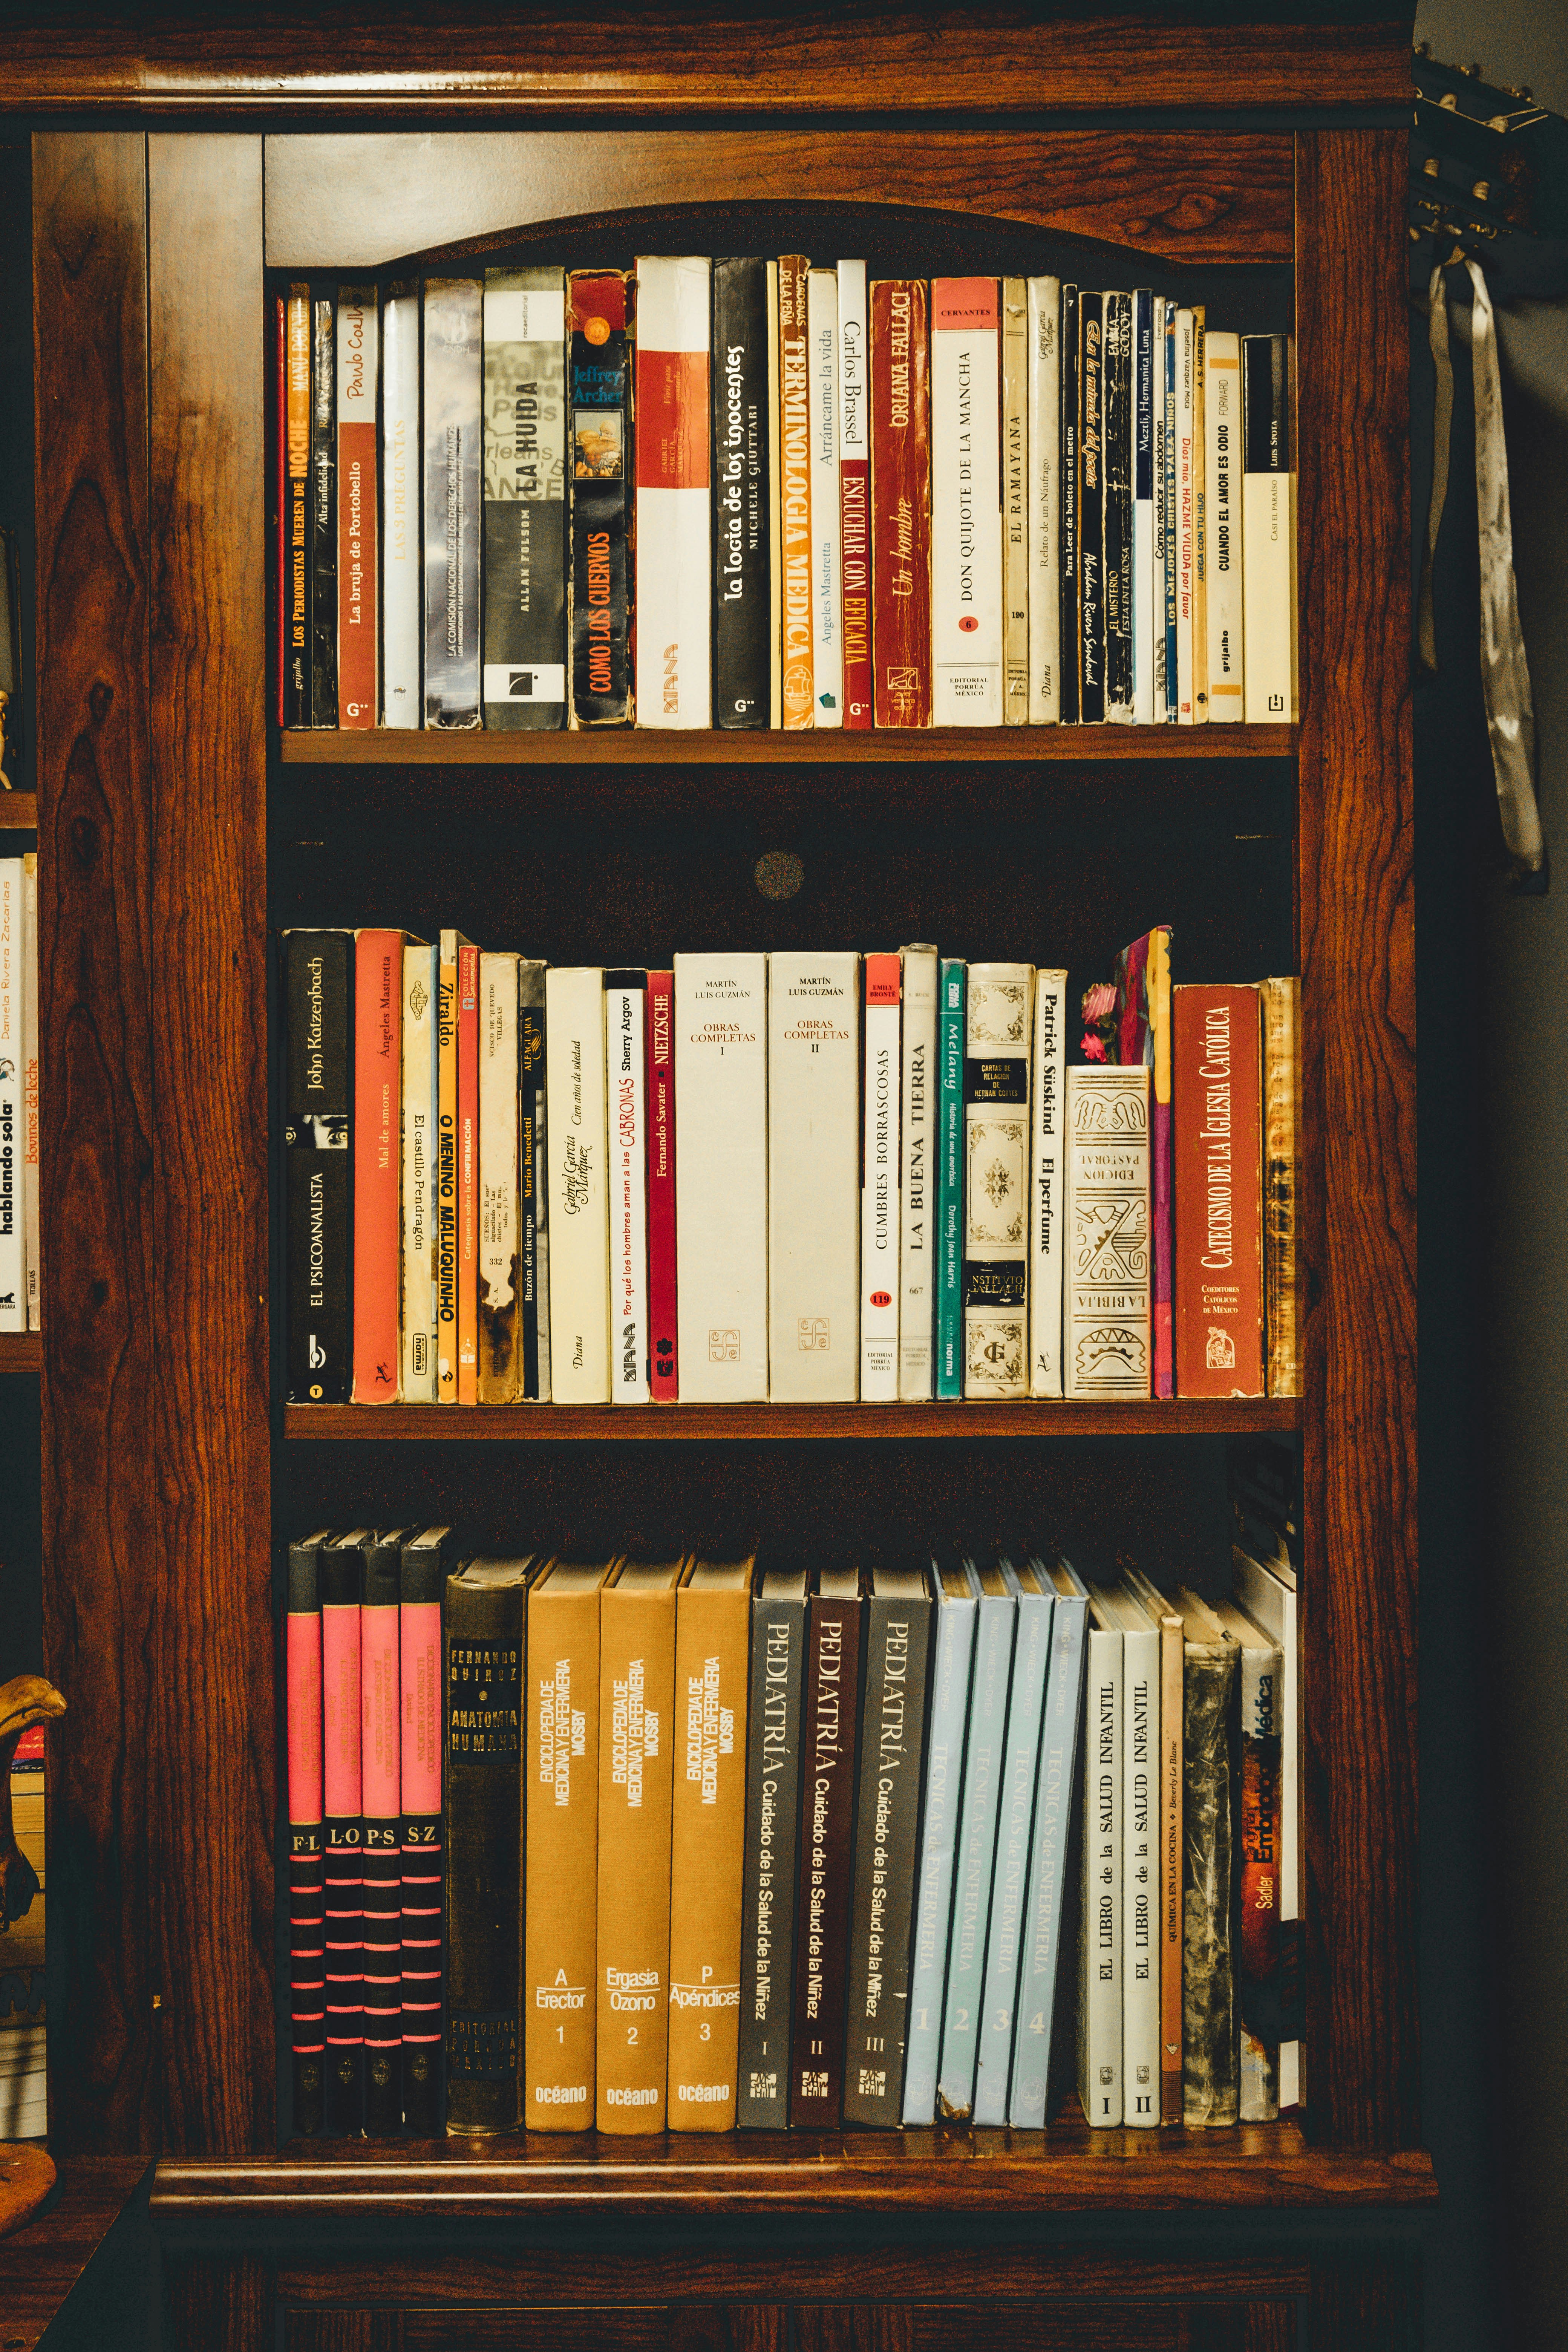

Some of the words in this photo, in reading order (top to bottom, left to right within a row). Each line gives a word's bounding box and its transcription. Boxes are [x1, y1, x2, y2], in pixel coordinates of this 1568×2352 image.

[891, 292, 909, 356] FALLACI
[820, 330, 831, 360] vida
[844, 322, 861, 377] Carlos
[820, 365, 831, 377] la
[723, 346, 744, 446] inocentes
[891, 363, 909, 426] ORIANA
[959, 352, 971, 425] MANCHA
[516, 382, 537, 452] HUIDA
[820, 383, 832, 466] Arráncame
[844, 385, 862, 444] Brassel
[289, 420, 308, 477] NOCHE
[749, 406, 761, 475] GIUTTARI
[960, 433, 971, 452] LA
[1218, 426, 1228, 451] ODIO
[723, 453, 744, 481] los
[960, 459, 971, 480] DE
[1010, 416, 1021, 514] RAMAYANA
[1066, 458, 1073, 467] el
[1067, 470, 1073, 481] en
[1219, 456, 1228, 469] ES
[294, 482, 304, 496] DE
[516, 464, 537, 492] LA
[1219, 473, 1228, 504] AMOR
[350, 462, 360, 536] Portobello
[723, 487, 742, 511] de
[292, 501, 305, 546] MUEREN
[749, 483, 758, 550] MICHELE
[844, 477, 865, 555] ESCUCHAR
[890, 498, 912, 560] hombre
[961, 487, 974, 557] QUIJOTE
[1066, 517, 1073, 528] de
[1219, 509, 1229, 521] EL
[521, 510, 529, 561] FOLSOM
[1011, 523, 1021, 543] EL
[1219, 525, 1229, 571] CUANDO
[350, 541, 360, 558] de
[350, 562, 363, 601] bruja
[588, 532, 611, 605] CUERVOS
[821, 543, 831, 596] Mastretta
[845, 561, 865, 591] CON
[892, 570, 913, 596] Un
[962, 565, 972, 601] DON
[292, 551, 305, 621] PERIODISTAS
[521, 568, 530, 612] ALLAN
[724, 579, 742, 600] la
[350, 606, 360, 624] La
[589, 609, 611, 641] LOS
[822, 600, 834, 645] Angeles
[292, 626, 304, 647] LOS
[845, 598, 867, 665] EFICACIA
[292, 658, 303, 689] grijalbo
[589, 646, 612, 692] COMO
[308, 957, 324, 1049] Katzenbach
[621, 996, 631, 1031] Argov
[654, 995, 669, 1064] NIETZSCHE
[784, 1031, 849, 1039] COMPLETAS
[798, 1020, 833, 1029] OBRAS
[1045, 994, 1057, 1058] Patrick
[571, 1041, 581, 1071] soledad
[622, 1035, 632, 1071] Sherry
[812, 1044, 819, 1053] II
[1199, 1007, 1231, 1078] CATÓLICA
[308, 1054, 323, 1089] John
[572, 1072, 581, 1083] de
[911, 1044, 924, 1125] TIERRA
[572, 1084, 581, 1104] años
[656, 1083, 666, 1122] Savater
[877, 1050, 888, 1164] BORRASCOSAS
[1043, 1065, 1056, 1135] Süskind
[0, 1103, 12, 1141] sola
[415, 1115, 424, 1128] El
[571, 1105, 582, 1125] Cien
[619, 1078, 635, 1147] CABRONAS
[1200, 1083, 1231, 1138] IGLESIA
[415, 1132, 423, 1177] castillo
[524, 1118, 533, 1165] Benedetti
[657, 1126, 666, 1177] Fernando
[1208, 1142, 1231, 1161] LA
[622, 1152, 630, 1167] las
[910, 1138, 924, 1210] BUENA
[1042, 1158, 1054, 1173] El
[1208, 1164, 1231, 1182] DE
[0, 1146, 12, 1235] hablando
[524, 1169, 532, 1197] Mario
[415, 1181, 424, 1250] Pendragón
[876, 1173, 888, 1250] CUMBRES
[1038, 1178, 1054, 1254] perfume
[311, 1173, 323, 1285] PSICOANALISTA
[525, 1215, 534, 1250] tiempo
[622, 1211, 631, 1256] hombres
[910, 1222, 923, 1250] LA
[1201, 1187, 1232, 1268] CATECISMO
[525, 1254, 533, 1266] de
[311, 1291, 323, 1306] EL
[622, 1279, 634, 1296] qué
[623, 1300, 632, 1315] Por
[815, 1620, 843, 1772] PEDIATRÍA
[1100, 1682, 1113, 1764] INFANTIL
[1170, 1767, 1176, 1777] Le
[1100, 1775, 1112, 1833] SALUD
[1169, 1779, 1178, 1808] Beverly
[813, 1778, 830, 1843] Cuidado
[331, 1828, 360, 1844] L-O
[368, 1829, 395, 1845] P-S
[408, 1826, 435, 1842] S-Z
[813, 1847, 826, 1867] de
[1100, 1845, 1112, 1857] la
[812, 1871, 825, 1885] la
[1100, 1868, 1112, 1884] de
[1169, 1866, 1176, 1879] LA
[1169, 1882, 1176, 1896] EN
[1255, 1876, 1274, 1909] Sadler
[810, 1888, 825, 1932] Salud
[1100, 1896, 1112, 1948] LIBRO
[1168, 1897, 1178, 1942] QUÍMICA
[810, 1936, 822, 1955] de
[555, 1968, 568, 1986] A
[607, 1967, 658, 1990] Ergasia
[702, 1966, 712, 1983] P
[808, 1958, 822, 1971] la
[1100, 1959, 1112, 1980] EL
[536, 1991, 586, 2009] Erector
[610, 1992, 655, 2011] Ozono
[669, 1986, 740, 2008] Apéndices
[807, 1975, 822, 2018] Niñez
[556, 2026, 564, 2043] 1
[628, 2027, 638, 2044] 2
[700, 2023, 710, 2041] 3
[811, 2041, 822, 2054] II
[535, 2086, 586, 2104] océano
[607, 2088, 658, 2105] océano
[678, 2084, 729, 2102] océano
